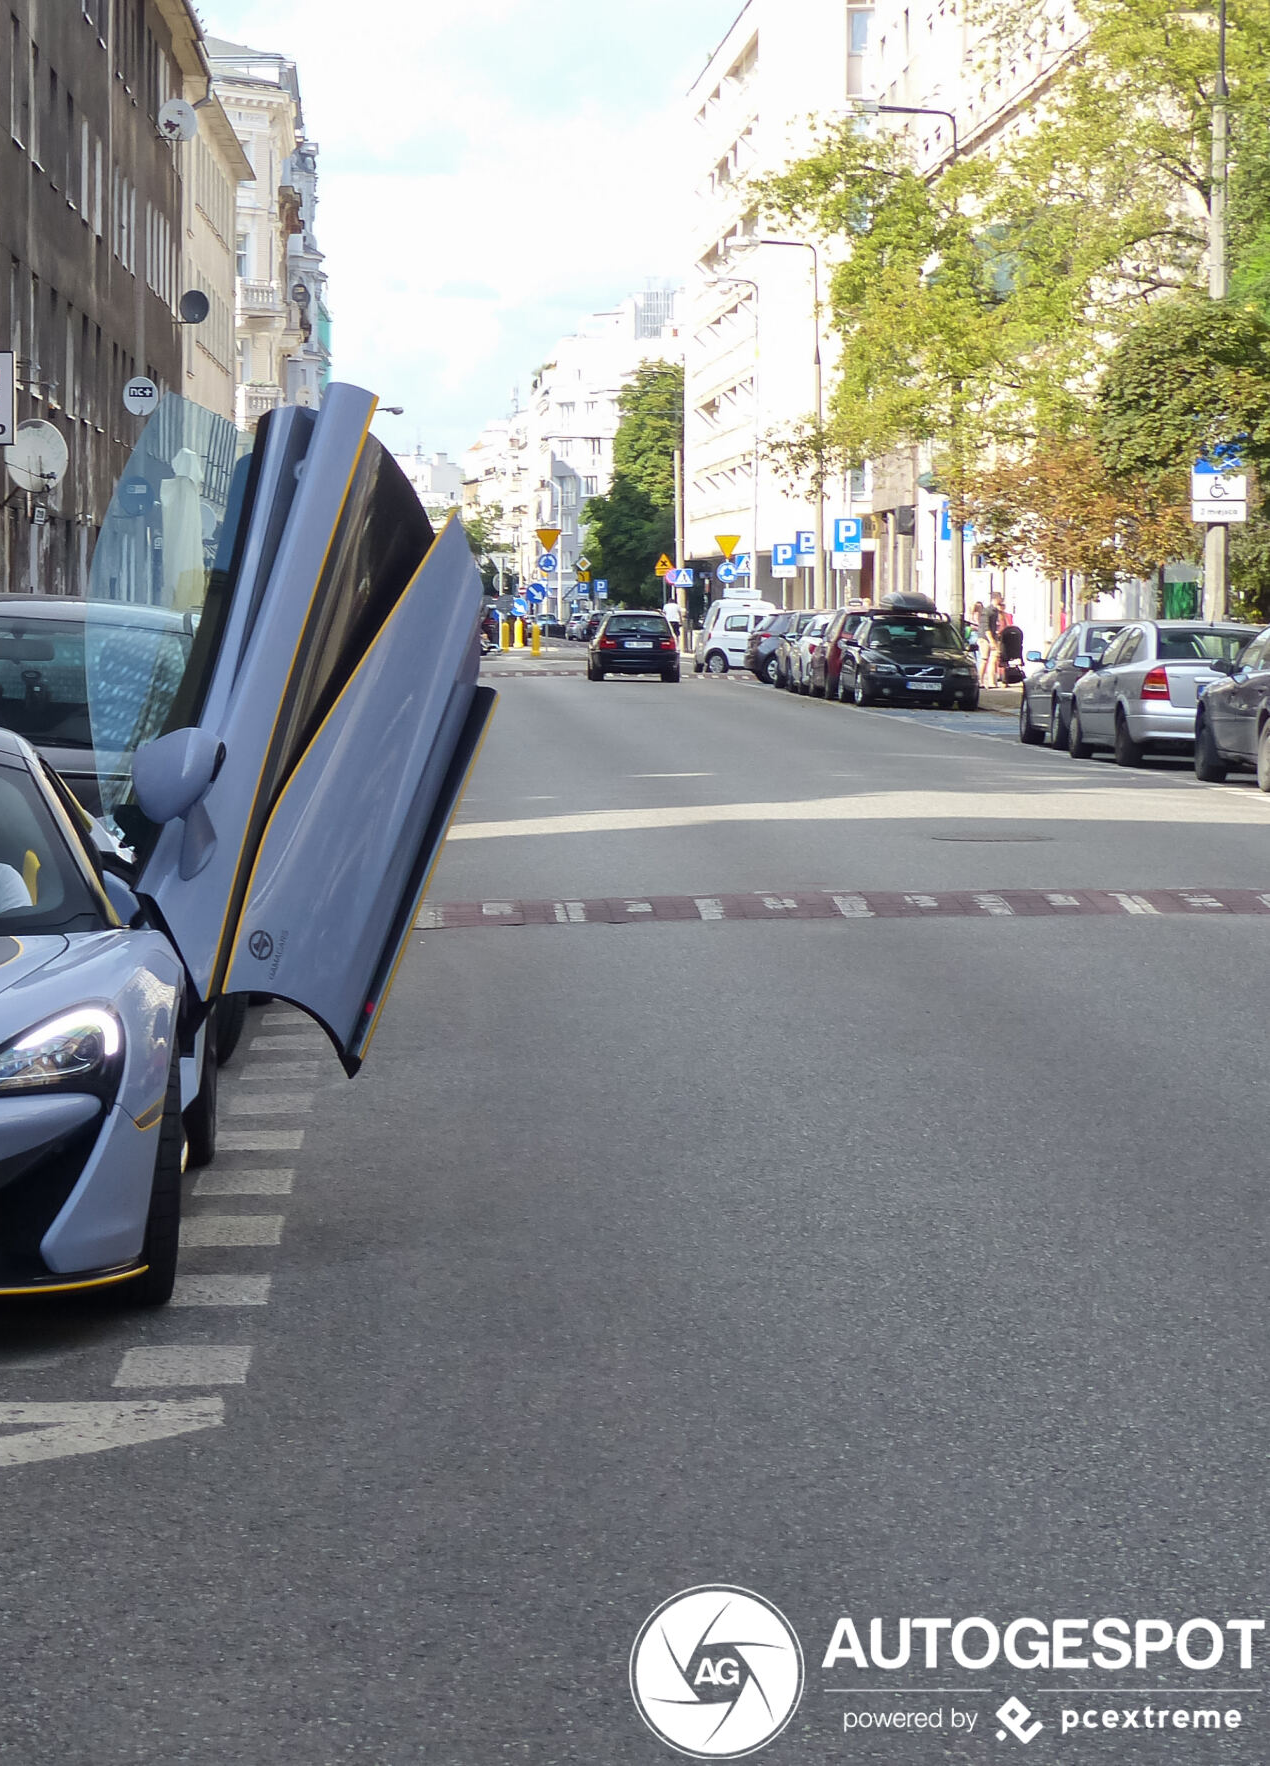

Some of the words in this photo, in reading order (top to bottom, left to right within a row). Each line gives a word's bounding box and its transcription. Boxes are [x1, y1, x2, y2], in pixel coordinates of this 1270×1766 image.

[130, 387, 153, 397] nc+
[838, 520, 857, 543] P
[799, 532, 815, 553] P
[777, 545, 793, 564] P
[579, 585, 588, 593] P
[596, 581, 606, 592] P
